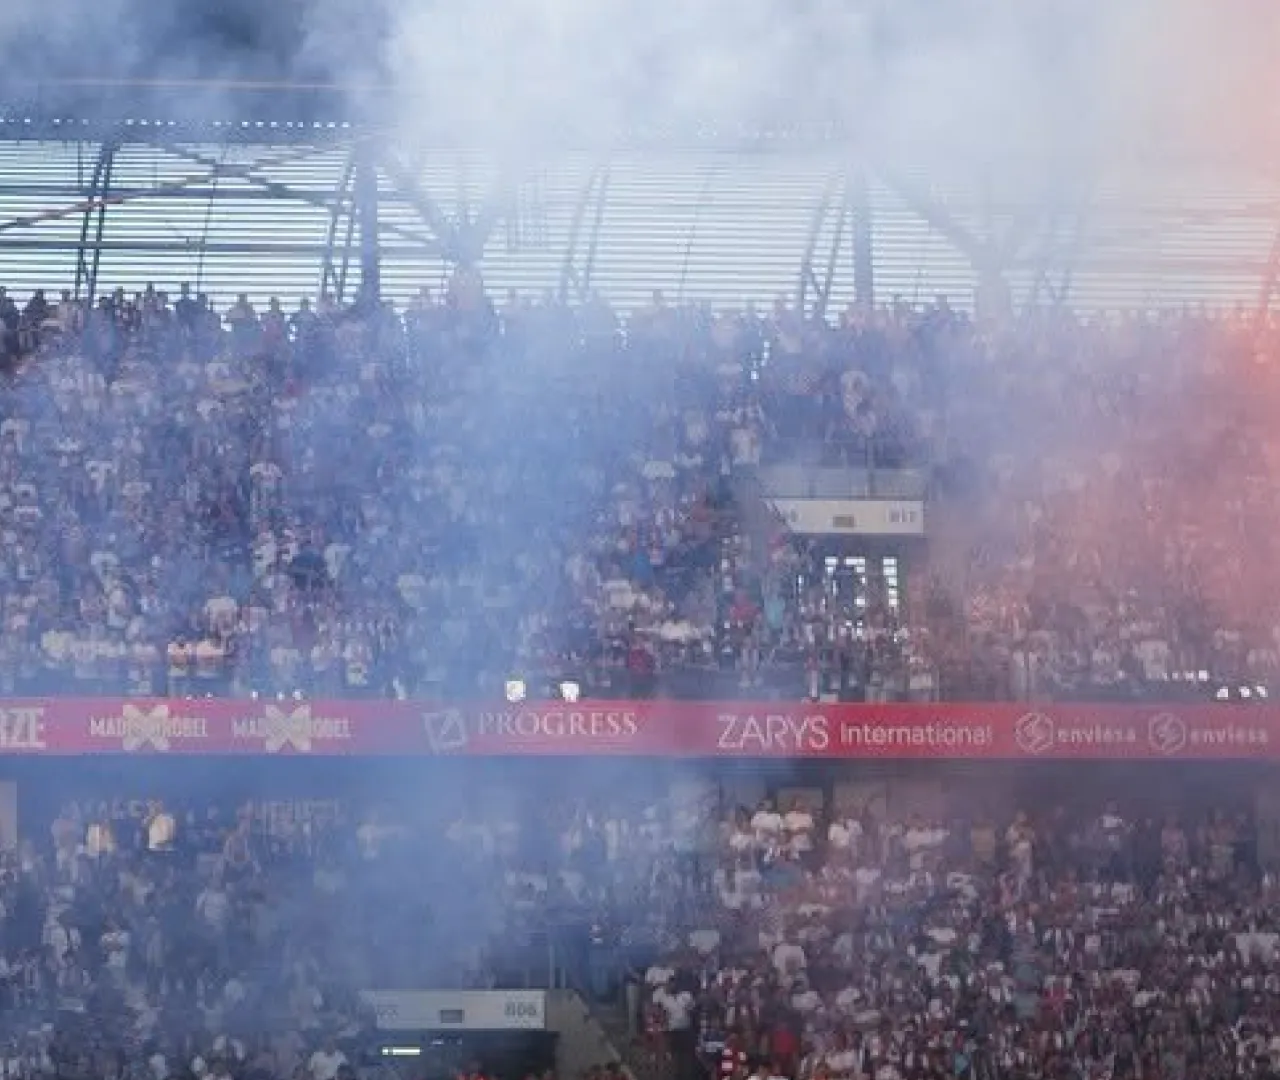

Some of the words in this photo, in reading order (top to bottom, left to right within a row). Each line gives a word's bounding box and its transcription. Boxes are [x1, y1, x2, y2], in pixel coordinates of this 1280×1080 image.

[475, 711, 639, 738] PROGRESS
[716, 714, 829, 751] ZARYS
[840, 721, 993, 747] International
